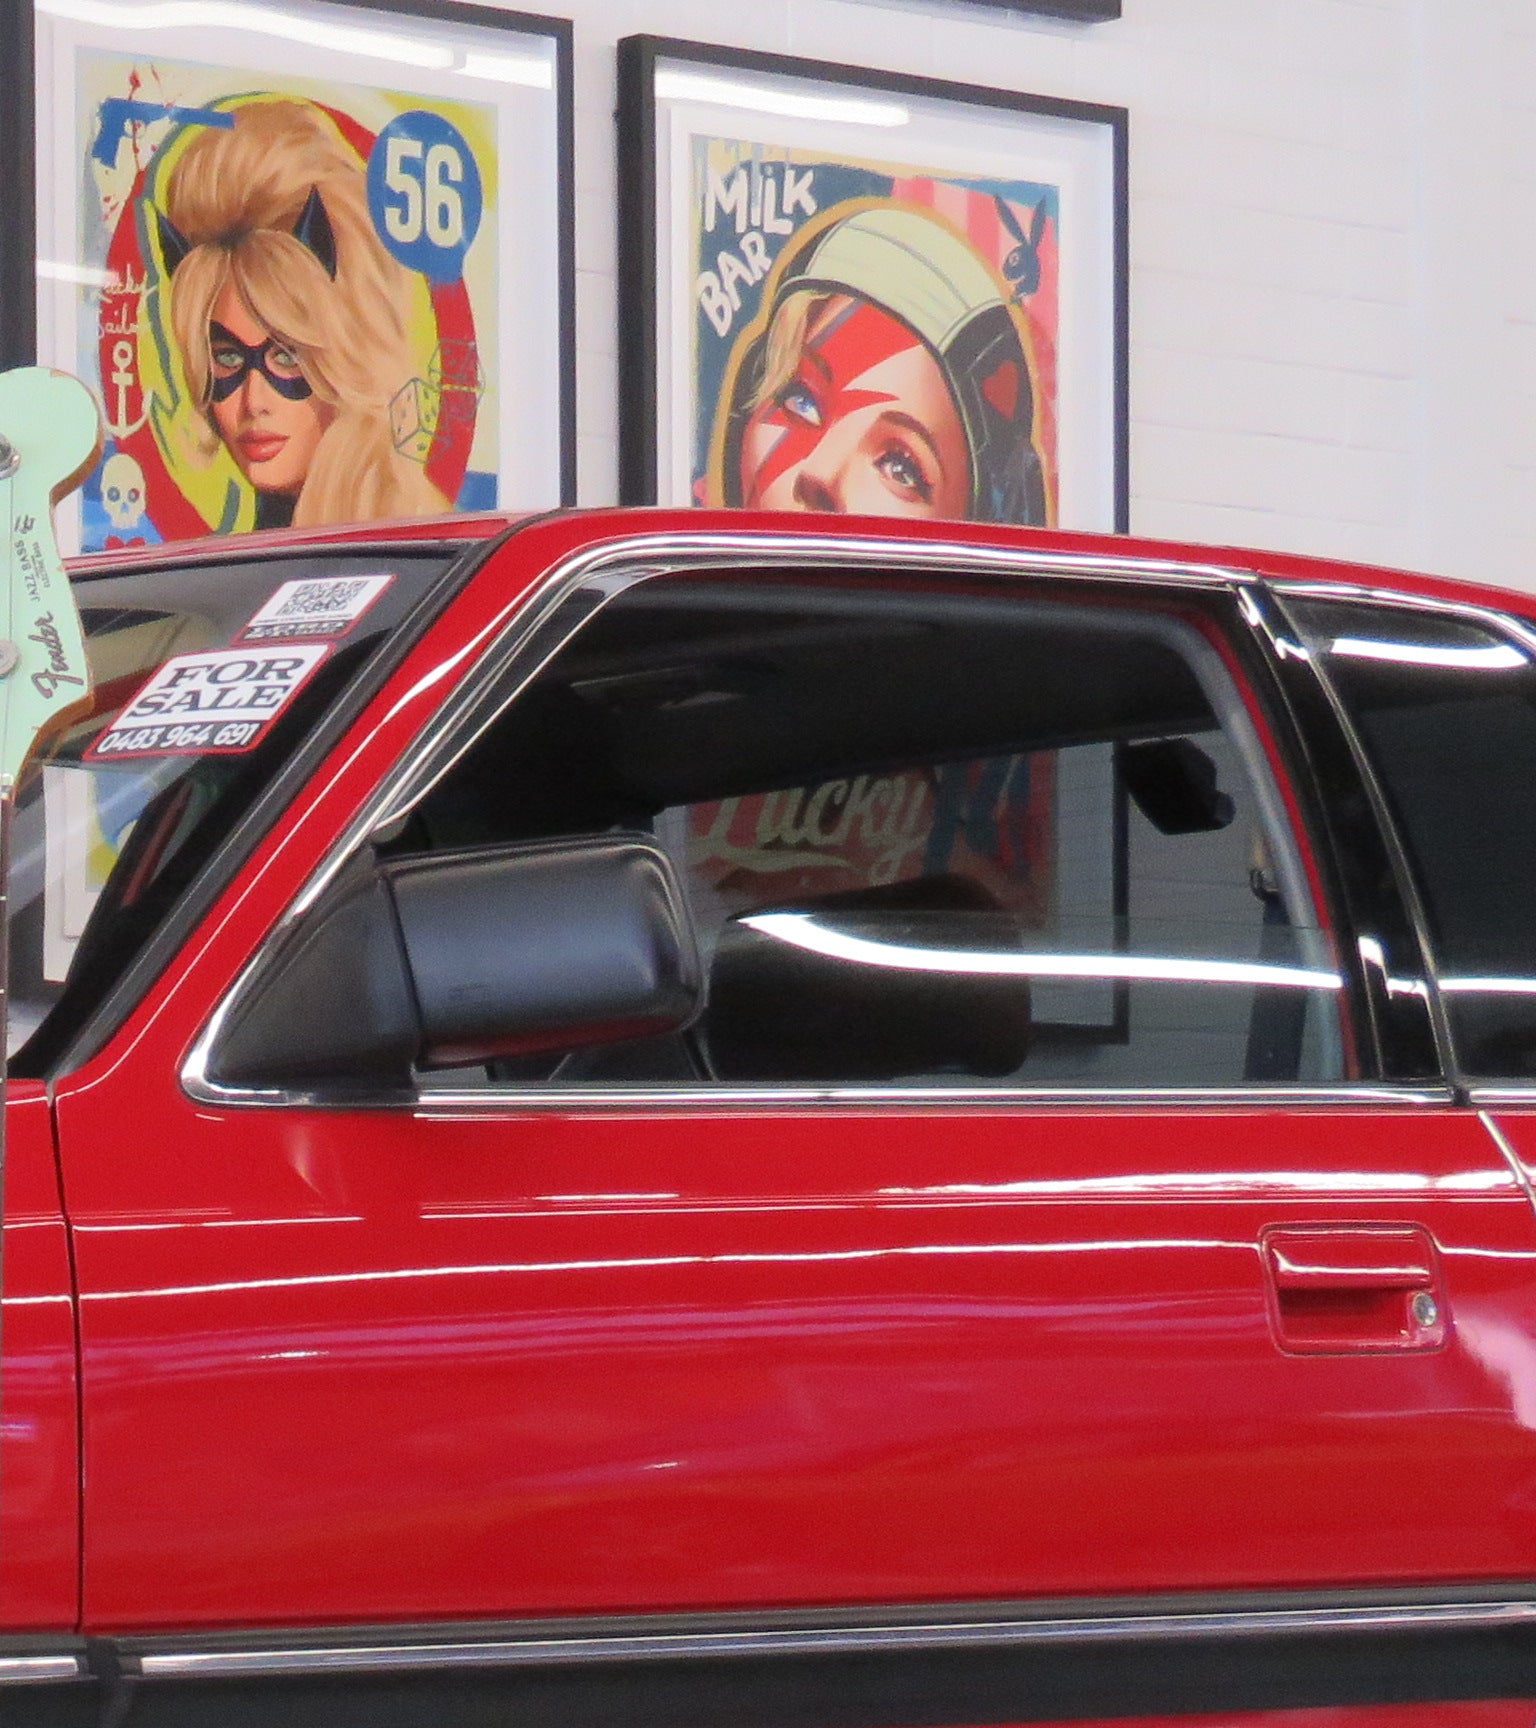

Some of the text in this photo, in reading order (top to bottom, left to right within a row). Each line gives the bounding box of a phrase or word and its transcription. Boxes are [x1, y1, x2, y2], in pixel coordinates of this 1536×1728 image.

[384, 136, 464, 249] 56
[698, 230, 772, 338] BAR
[28, 611, 85, 699] Fender
[158, 657, 306, 691] FOR
[126, 685, 291, 719] SALE
[96, 723, 261, 753] 0483 964 691
